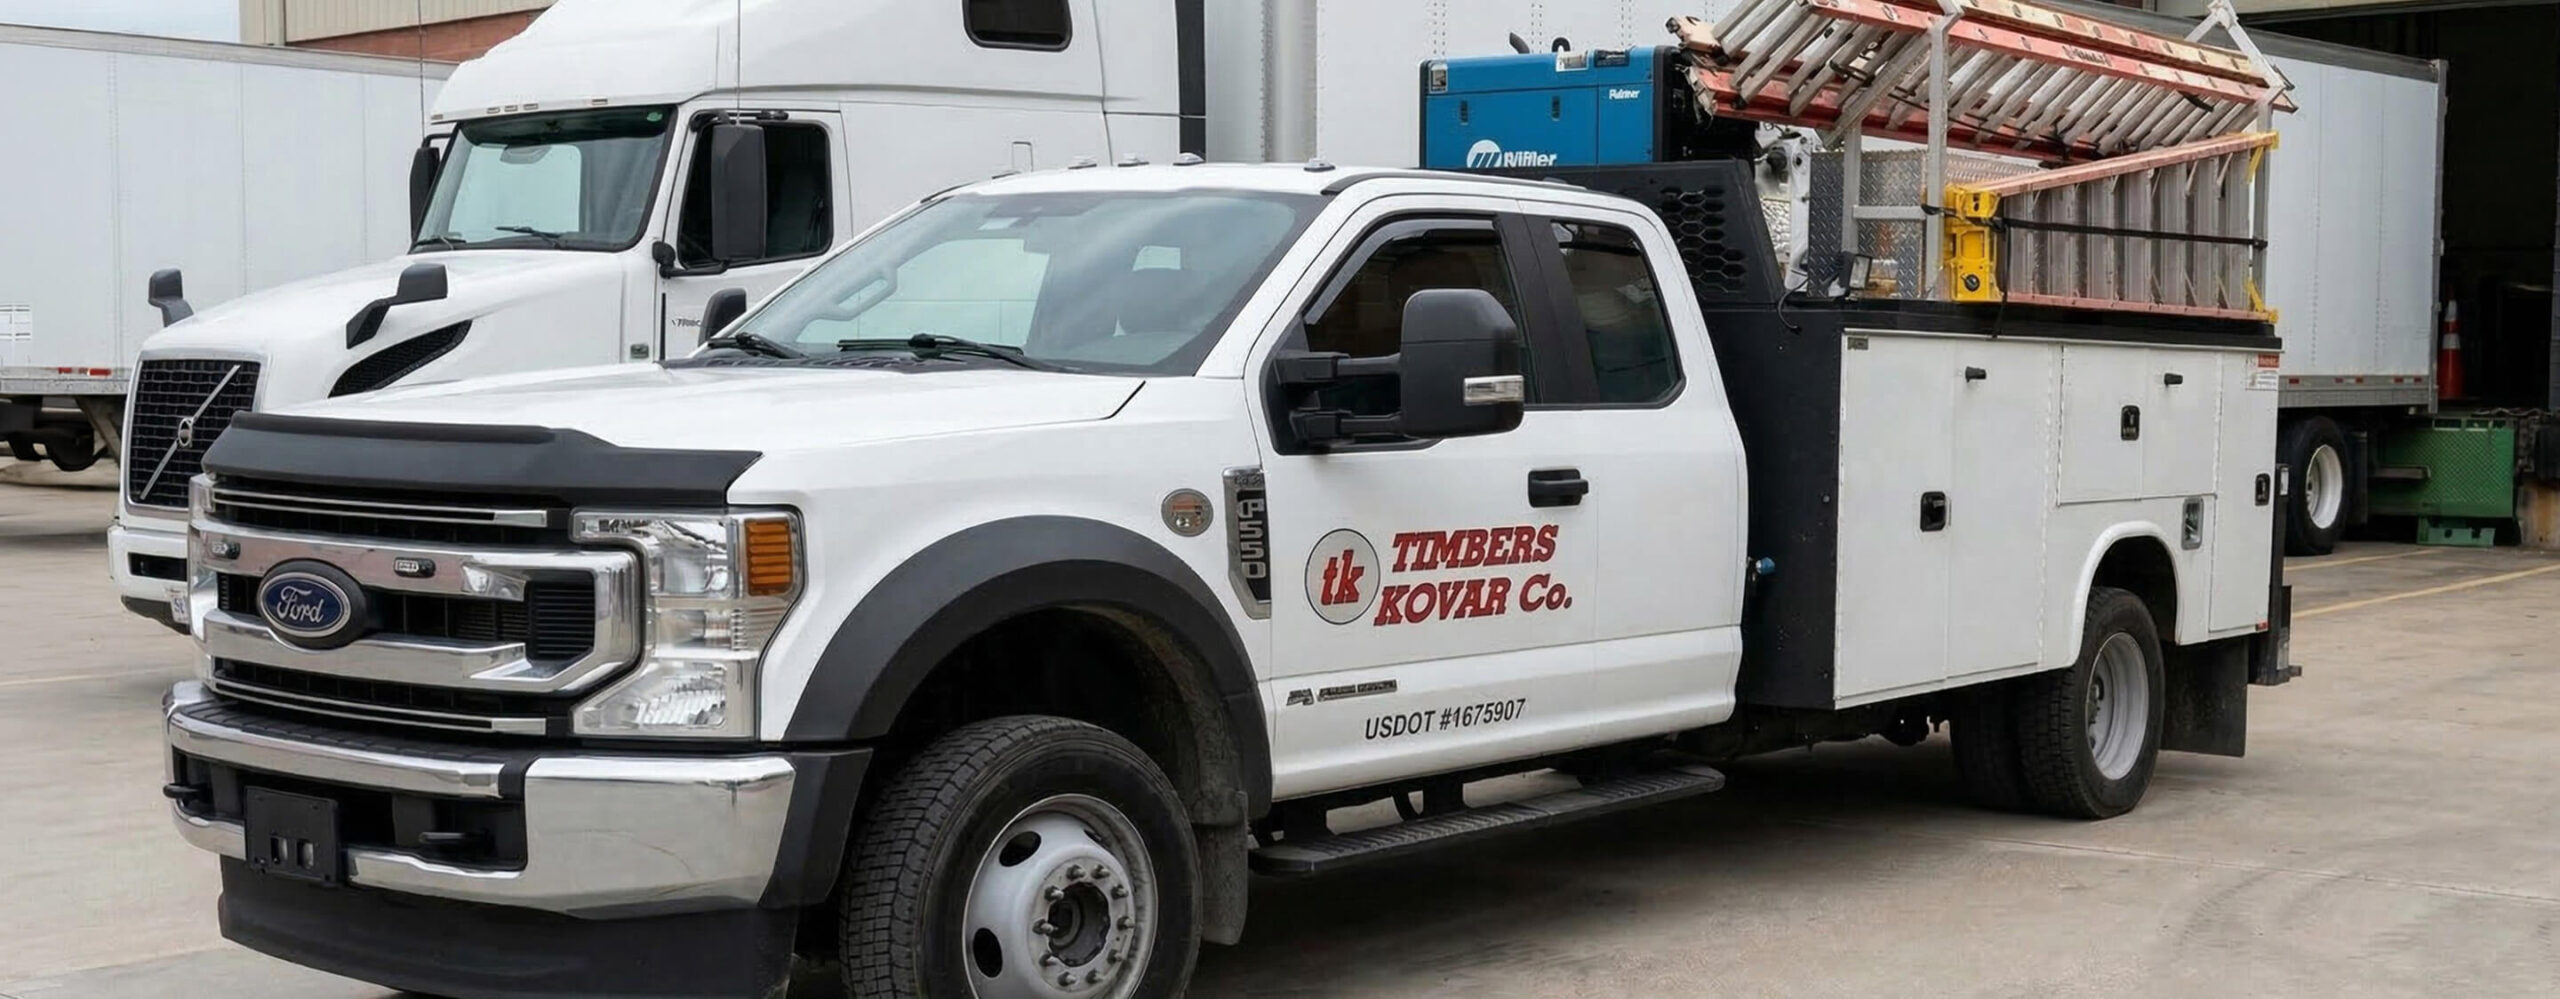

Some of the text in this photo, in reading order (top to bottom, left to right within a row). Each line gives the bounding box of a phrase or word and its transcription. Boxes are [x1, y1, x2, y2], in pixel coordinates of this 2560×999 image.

[1391, 524, 1559, 573] TIMBERS
[1321, 549, 1365, 606] tk
[1373, 573, 1573, 627] KOVAR Co.
[276, 585, 325, 623] Ford
[1365, 698, 1527, 740] USDOT #1675907
